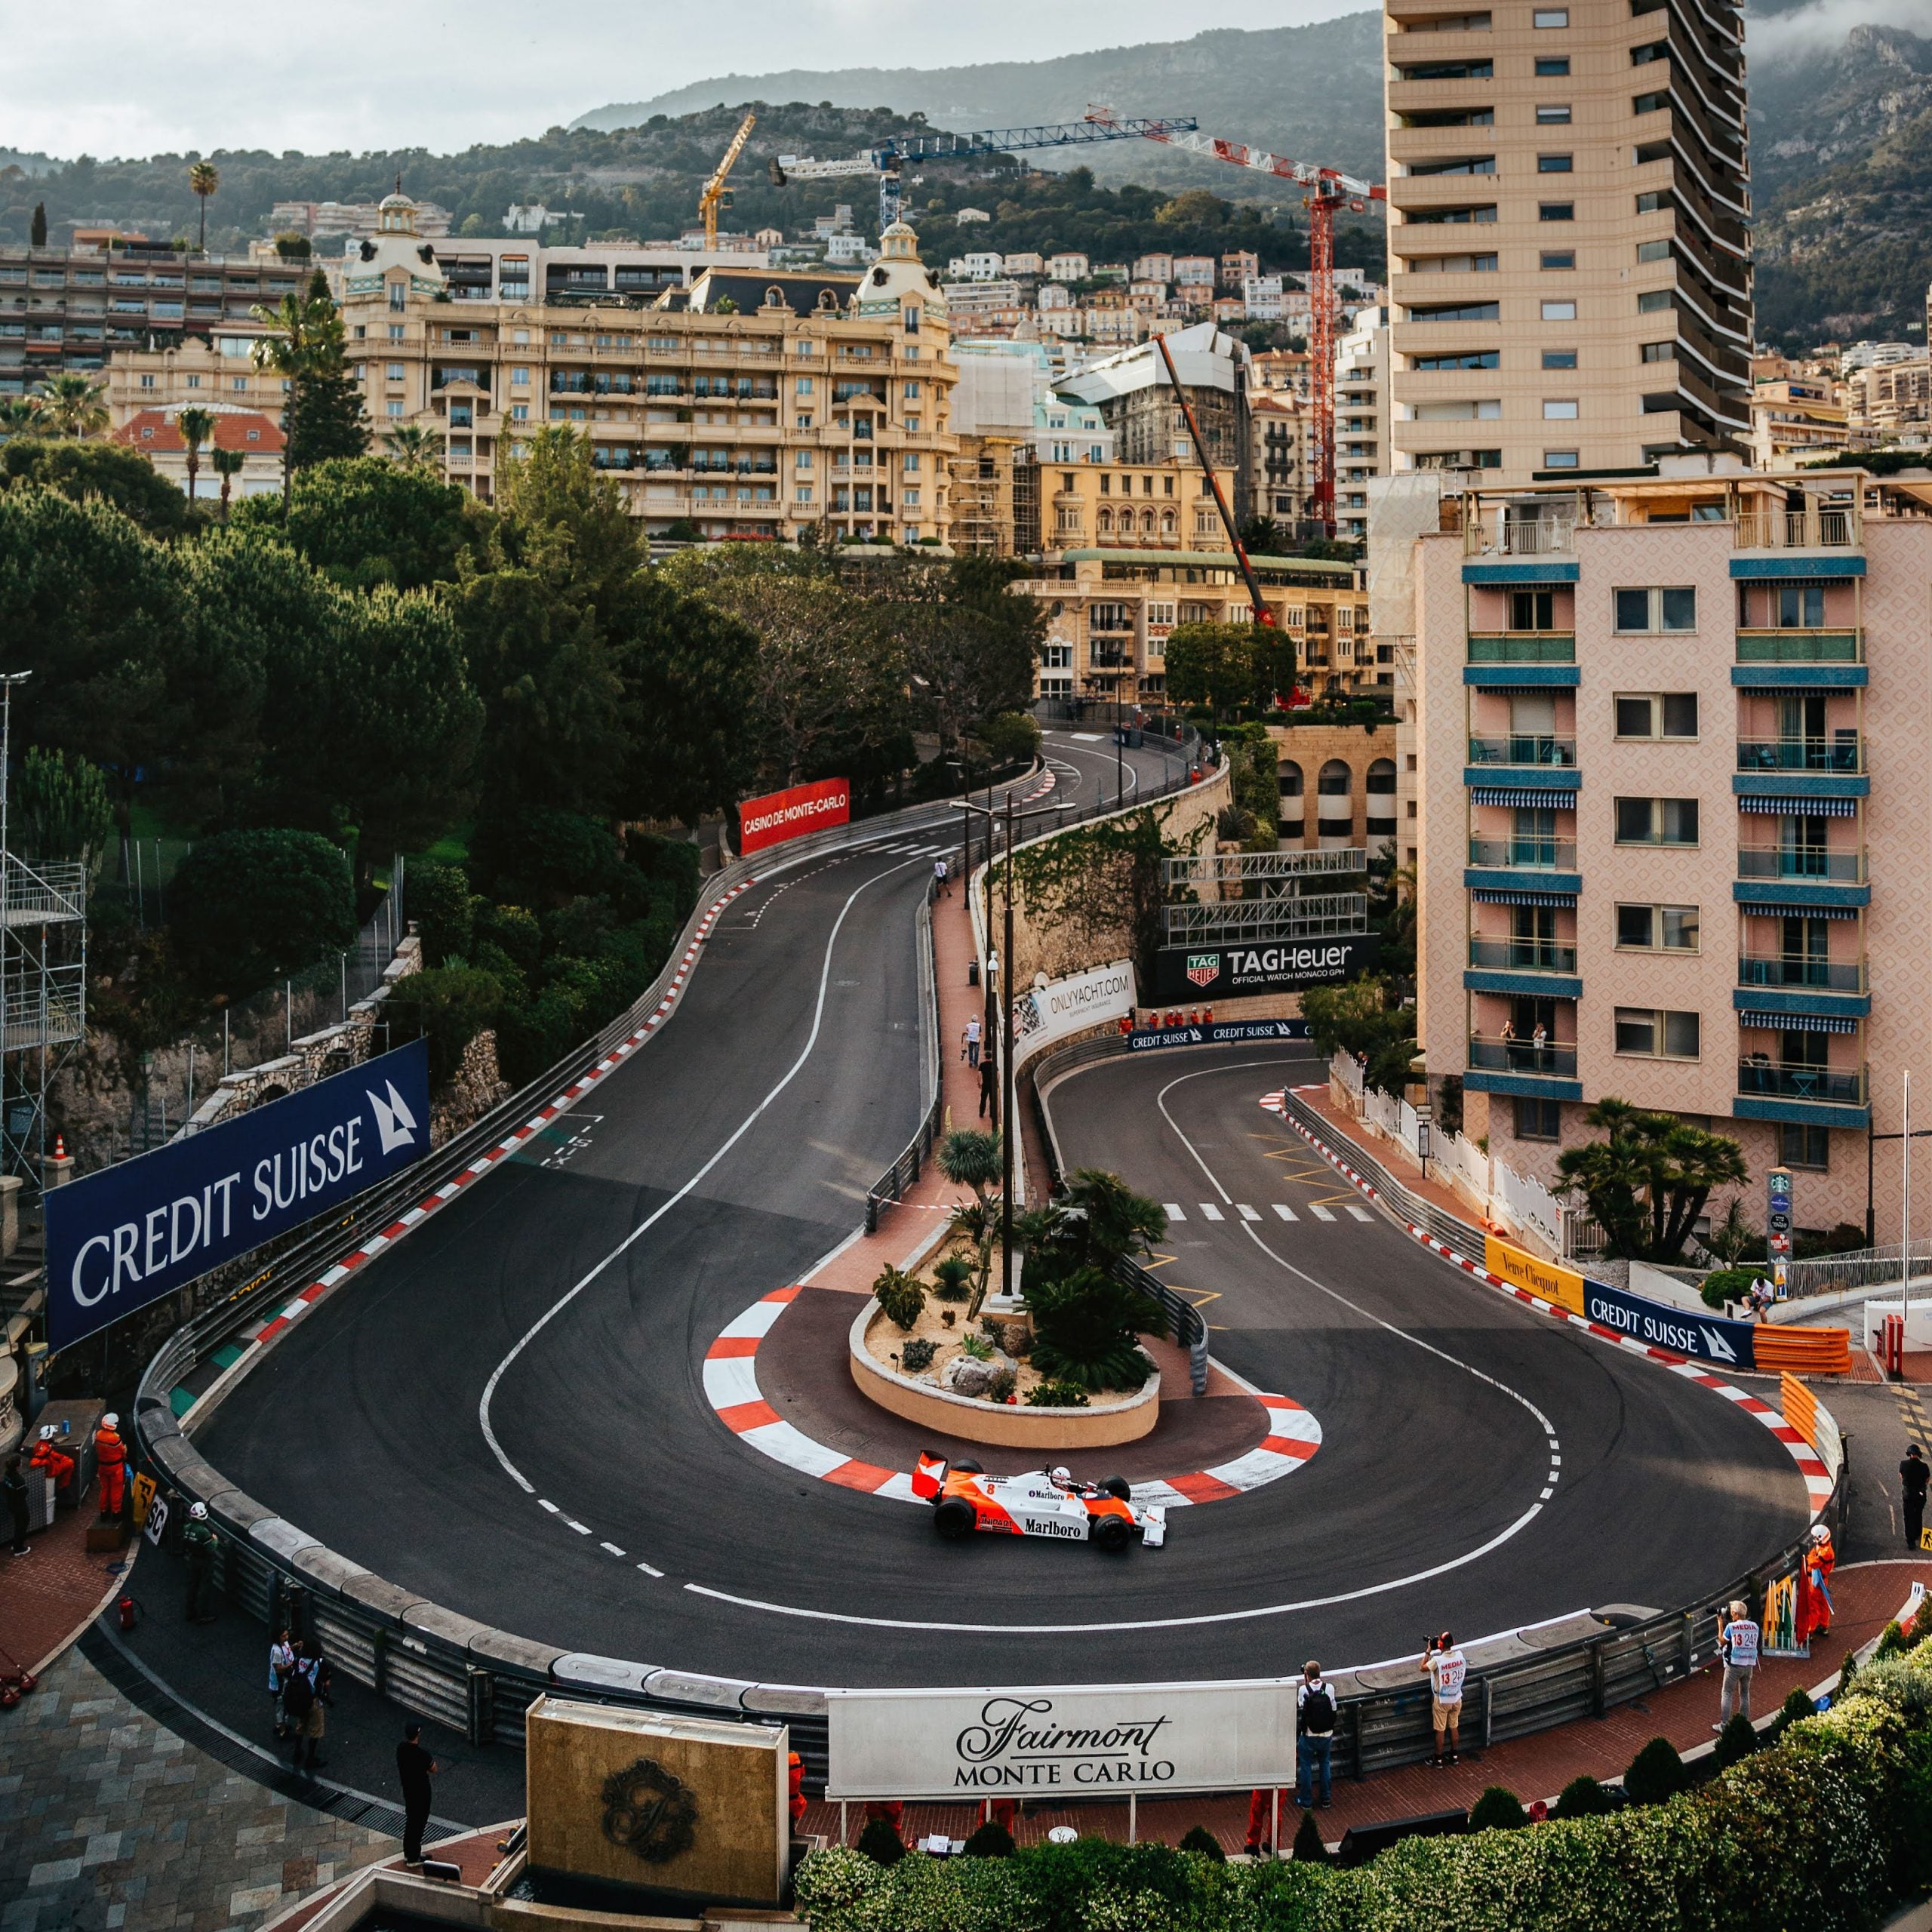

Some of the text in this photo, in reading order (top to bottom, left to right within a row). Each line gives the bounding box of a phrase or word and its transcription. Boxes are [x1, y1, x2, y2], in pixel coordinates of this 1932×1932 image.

[744, 794, 846, 835] CASINO DE MONTE-CARLO
[1190, 955, 1217, 967] TAG
[1189, 967, 1217, 985] HEUER
[1232, 968, 1345, 985] OFFICIAL WATCH MONACO GPH
[1051, 975, 1129, 1014] ONLYYACHT.COM
[1133, 1032, 1189, 1048] CREDIT SUISSE
[1213, 1025, 1275, 1040] CREDIT SUISSE
[72, 1115, 364, 1307] CREDIT SUISSE
[1502, 1252, 1559, 1296] Veuve Clicquot
[1591, 1297, 1698, 1353] CREDIT SUISSE
[986, 1483, 995, 1495] 8
[1035, 1490, 1065, 1501] Marlboro
[146, 1502, 165, 1537] SC
[977, 1516, 1013, 1527] UNIPART
[1025, 1518, 1081, 1537] Marlboro
[1734, 1633, 1743, 1647] 13
[1441, 1660, 1463, 1670] MEDIA
[1441, 1672, 1451, 1685] 13
[955, 1697, 1173, 1763] Fairmont
[953, 1760, 1176, 1787] MONTE CARLO
